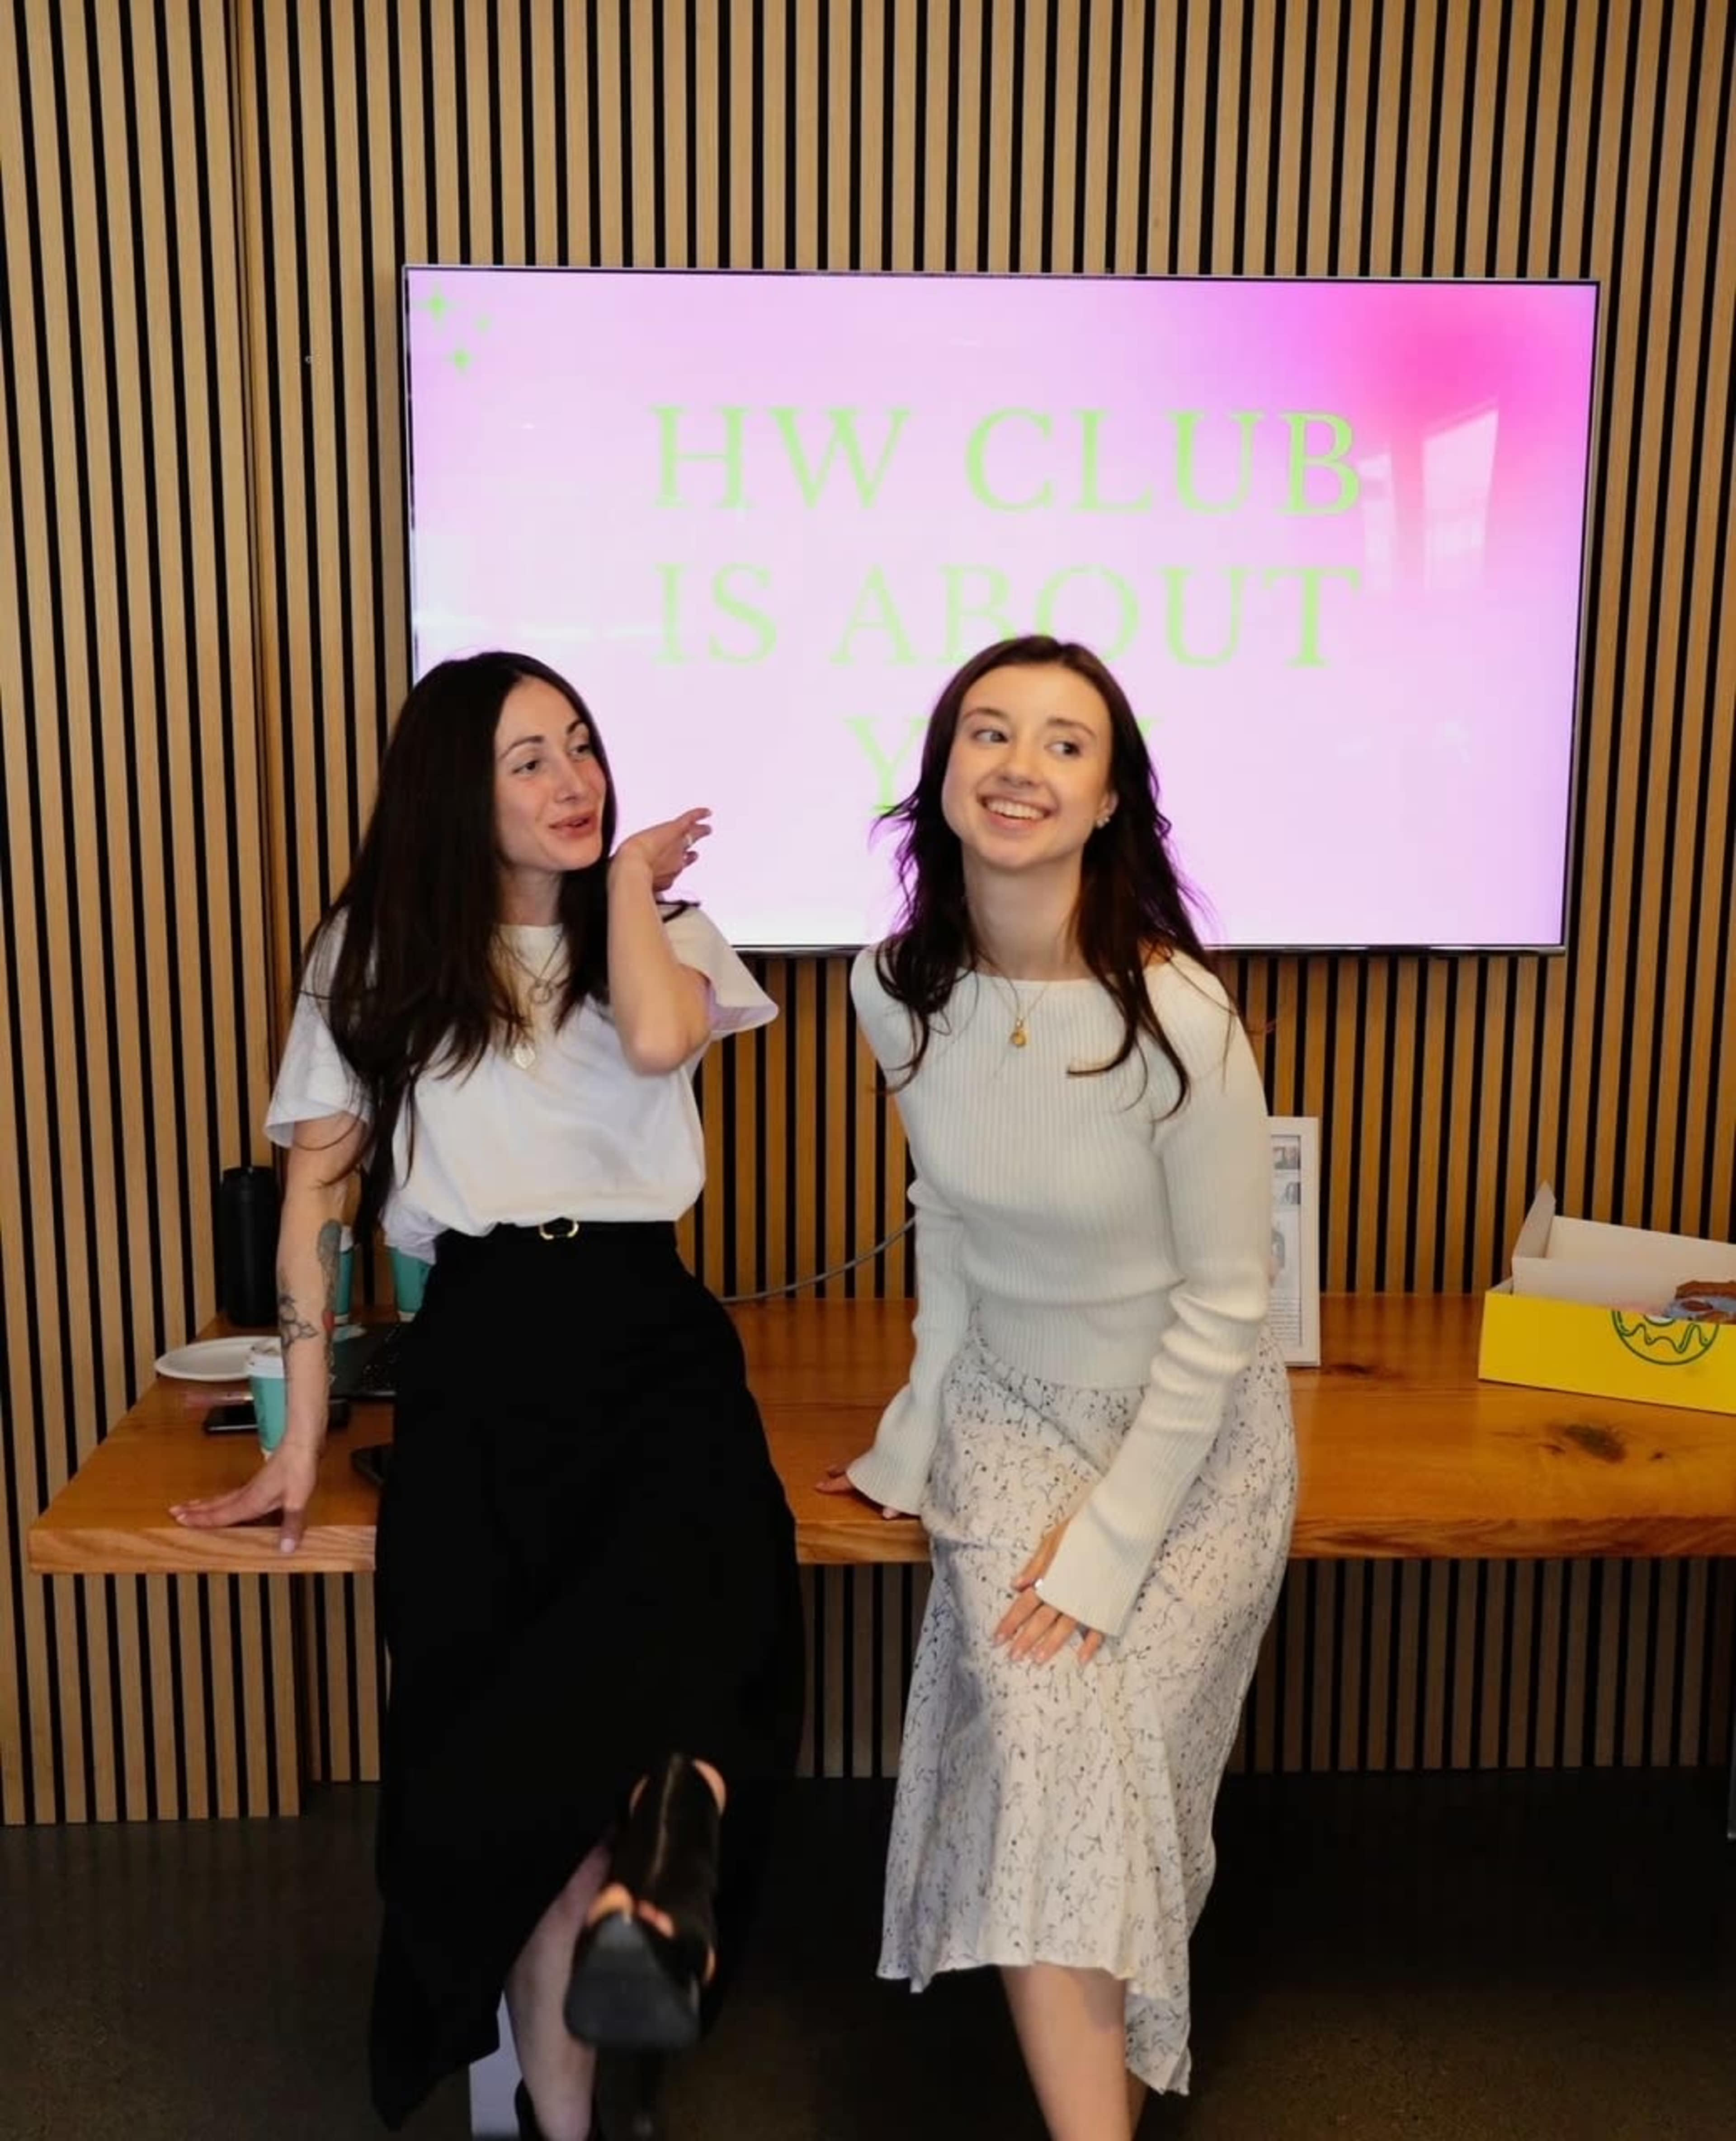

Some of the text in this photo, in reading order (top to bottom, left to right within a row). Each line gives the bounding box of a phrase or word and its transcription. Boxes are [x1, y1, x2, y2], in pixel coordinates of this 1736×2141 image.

[649, 402, 1364, 517] HW CLUB
[654, 561, 1363, 670] IS ABOUT
